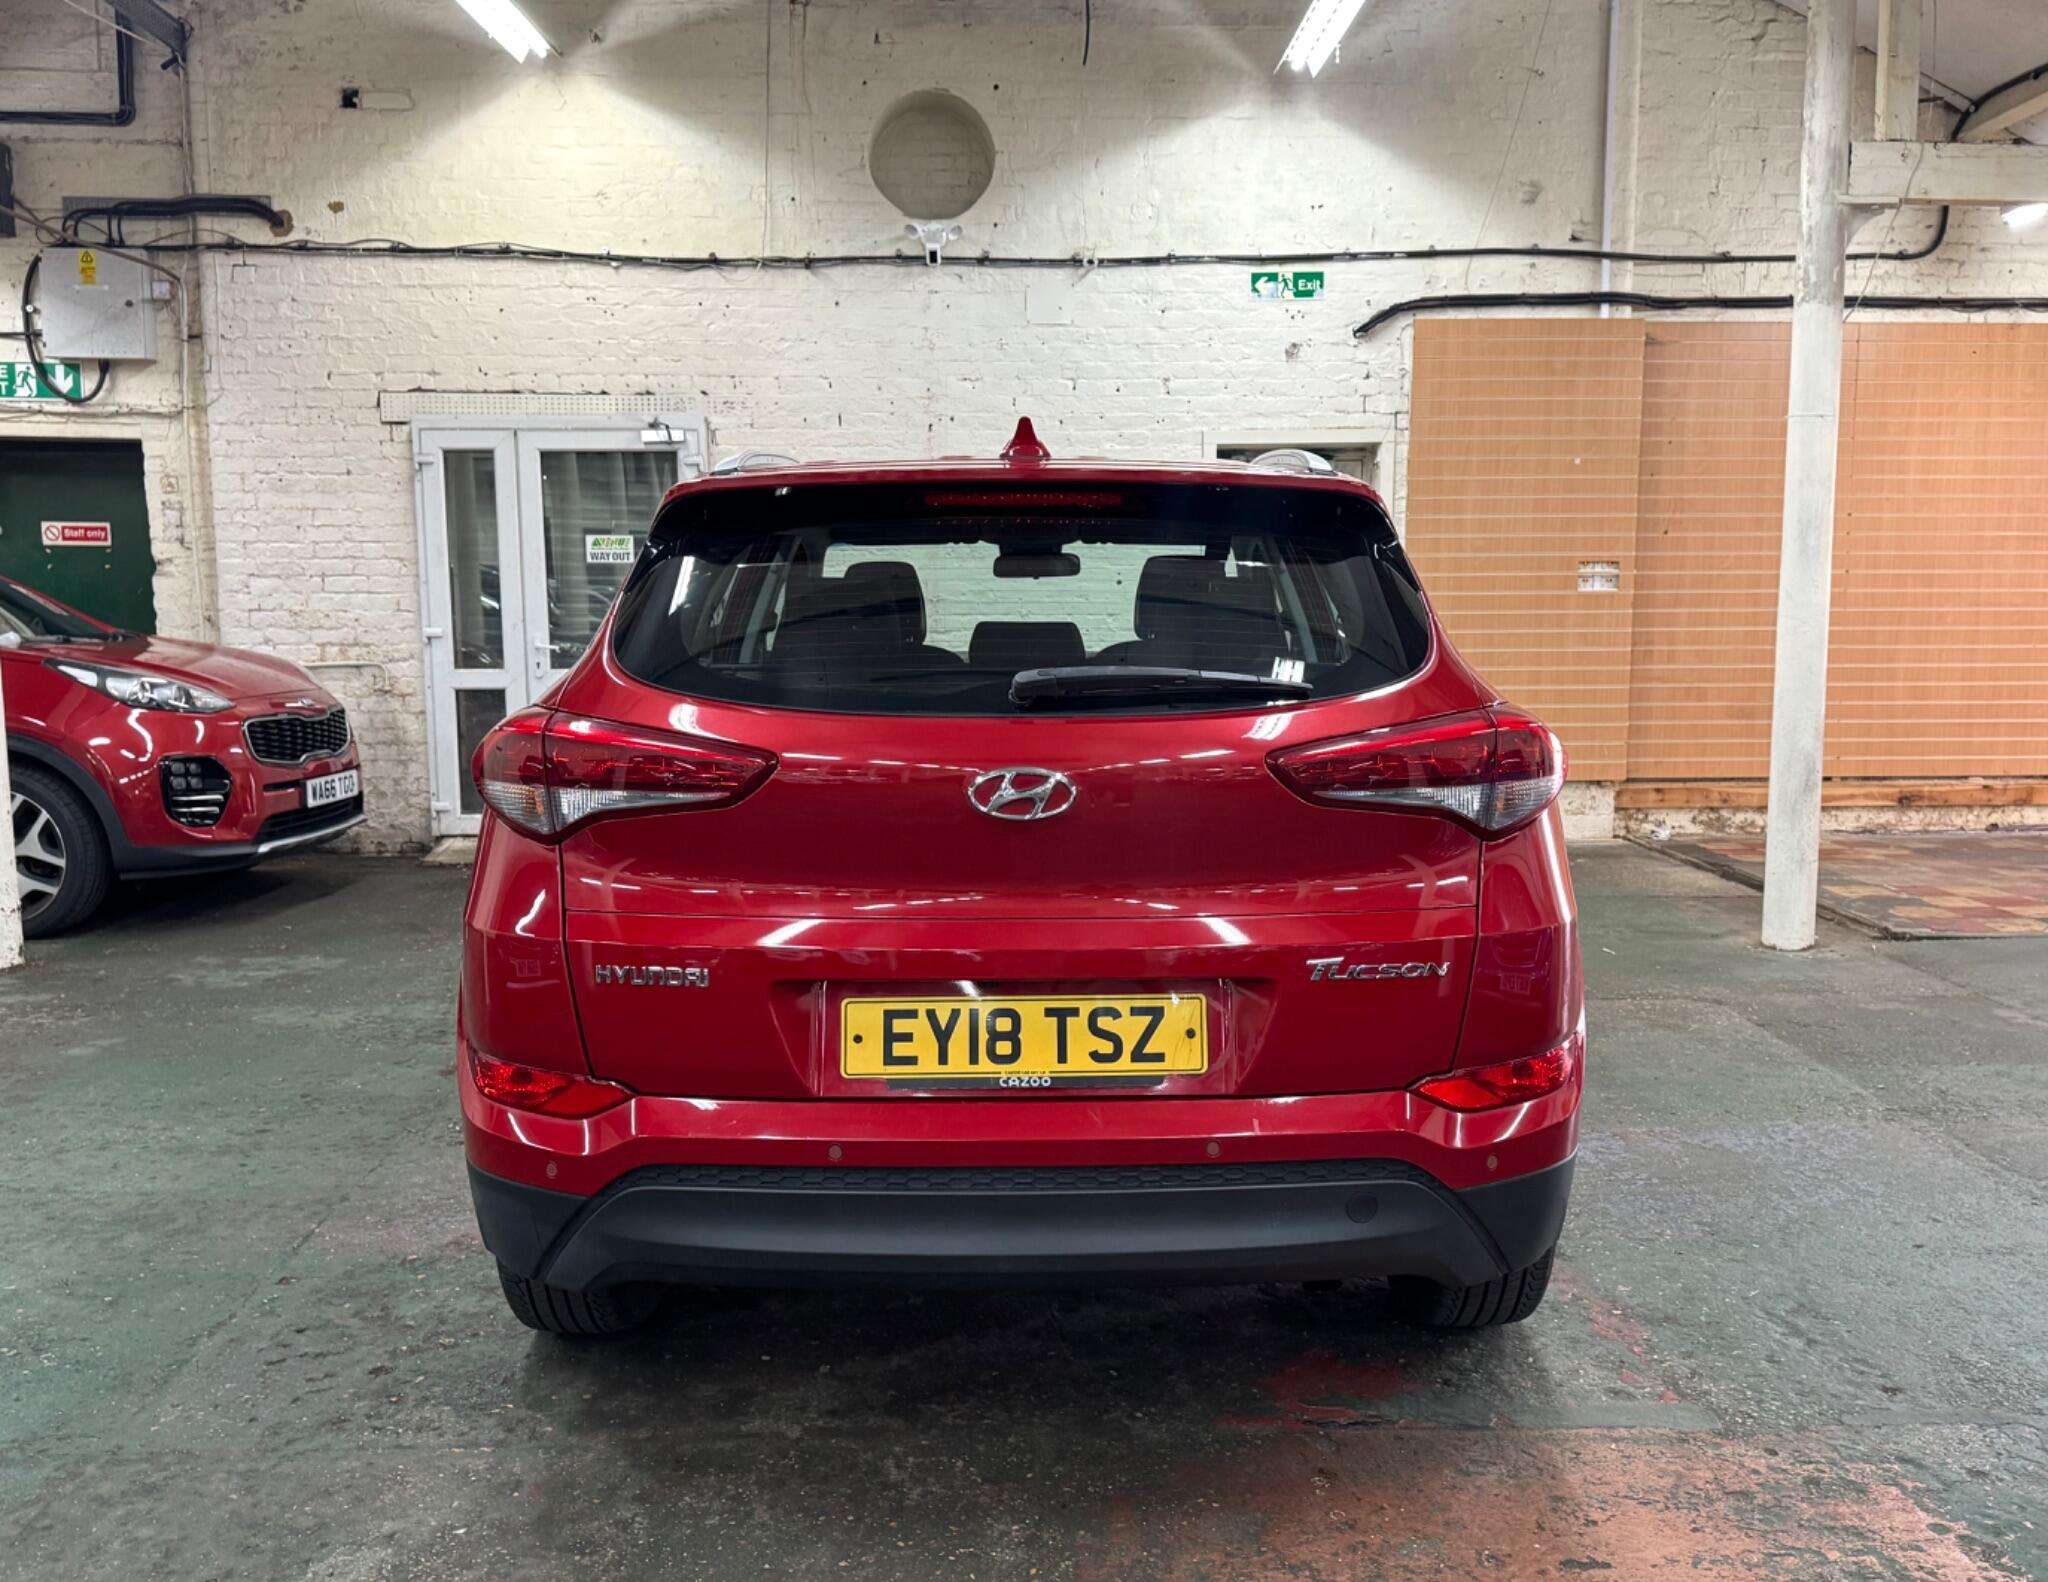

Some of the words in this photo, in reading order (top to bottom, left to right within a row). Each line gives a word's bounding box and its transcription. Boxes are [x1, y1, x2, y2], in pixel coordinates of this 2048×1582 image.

[1298, 279, 1321, 291] Exit
[63, 528, 84, 538] Staff
[86, 528, 106, 539] only
[590, 552, 610, 561] WAY
[612, 552, 630, 561] OUT
[1306, 956, 1450, 981] TUCSON
[595, 965, 709, 987] HYUNDAI
[883, 1008, 1022, 1066] EY18
[1044, 1005, 1166, 1064] TSZ
[999, 1077, 1051, 1087] CAZOO
